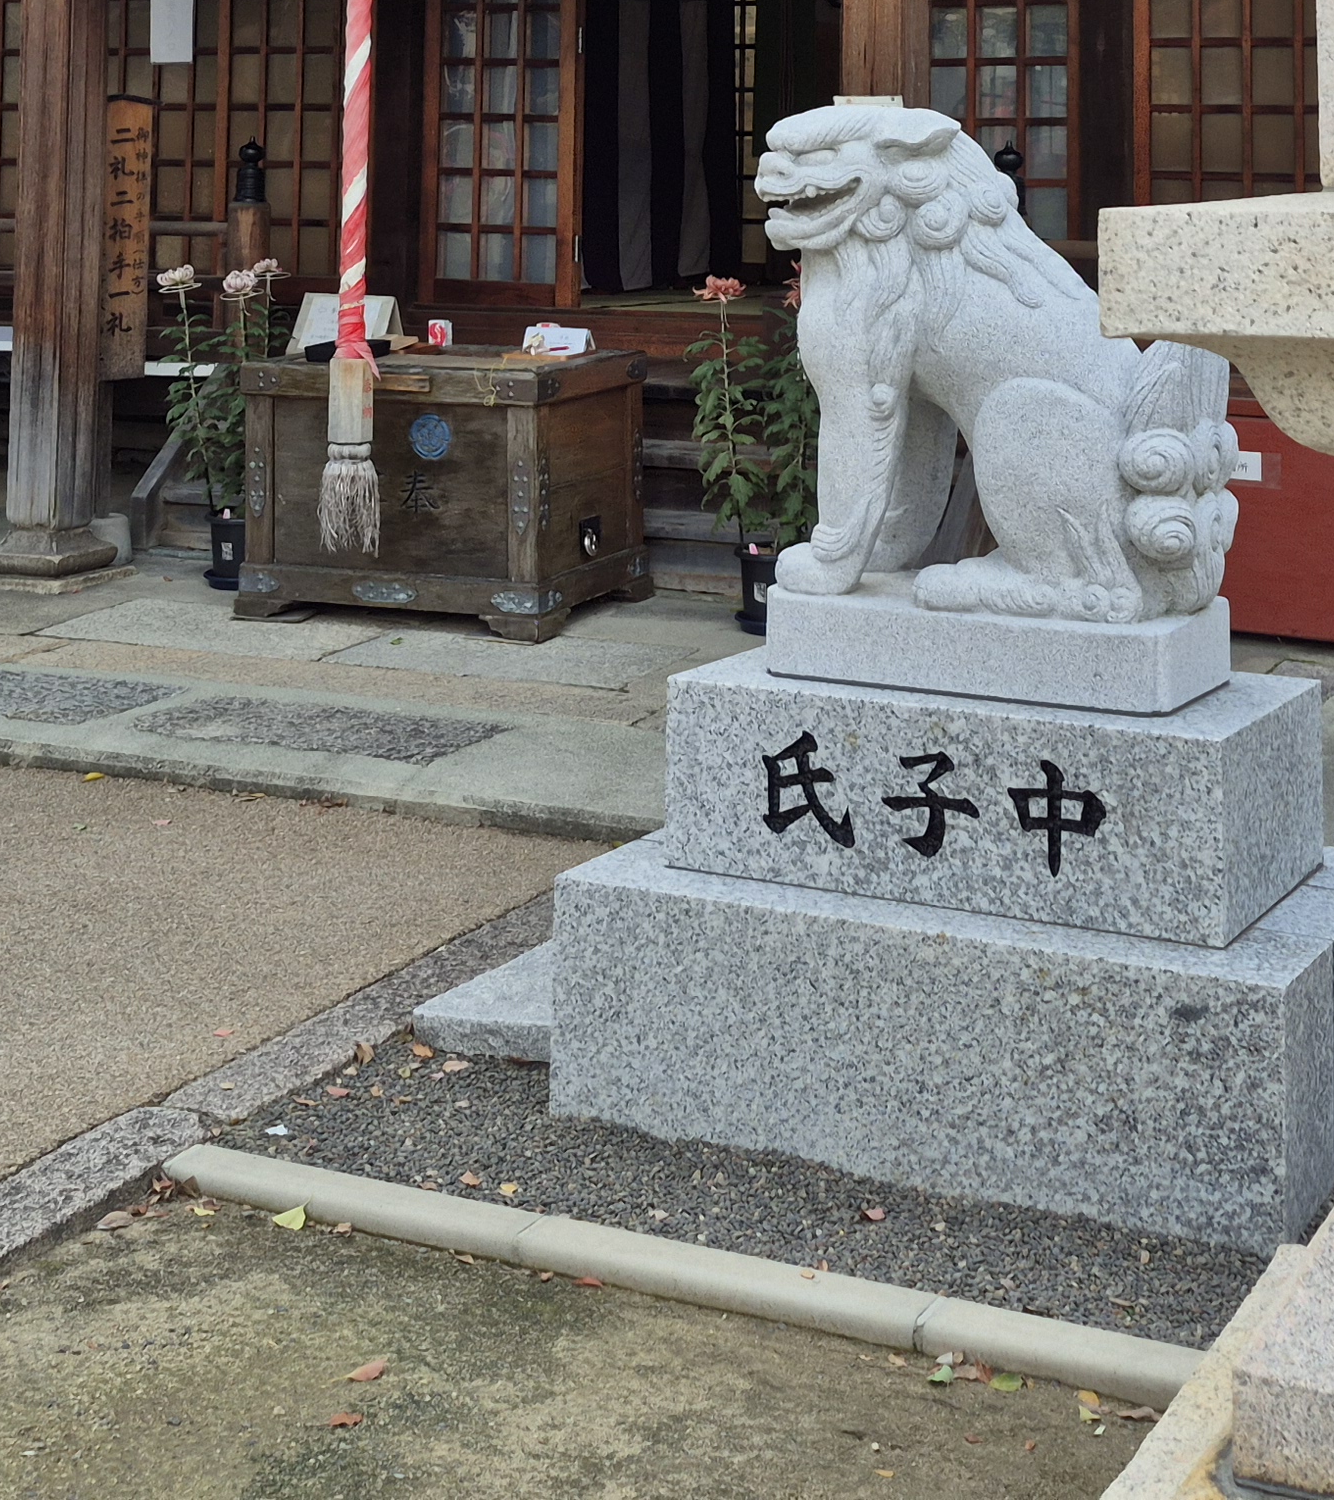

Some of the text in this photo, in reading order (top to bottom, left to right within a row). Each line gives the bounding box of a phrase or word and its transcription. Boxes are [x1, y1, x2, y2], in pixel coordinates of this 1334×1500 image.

[107, 127, 135, 337] 二礼二拍手一礼
[762, 730, 1107, 877] 氏子中
